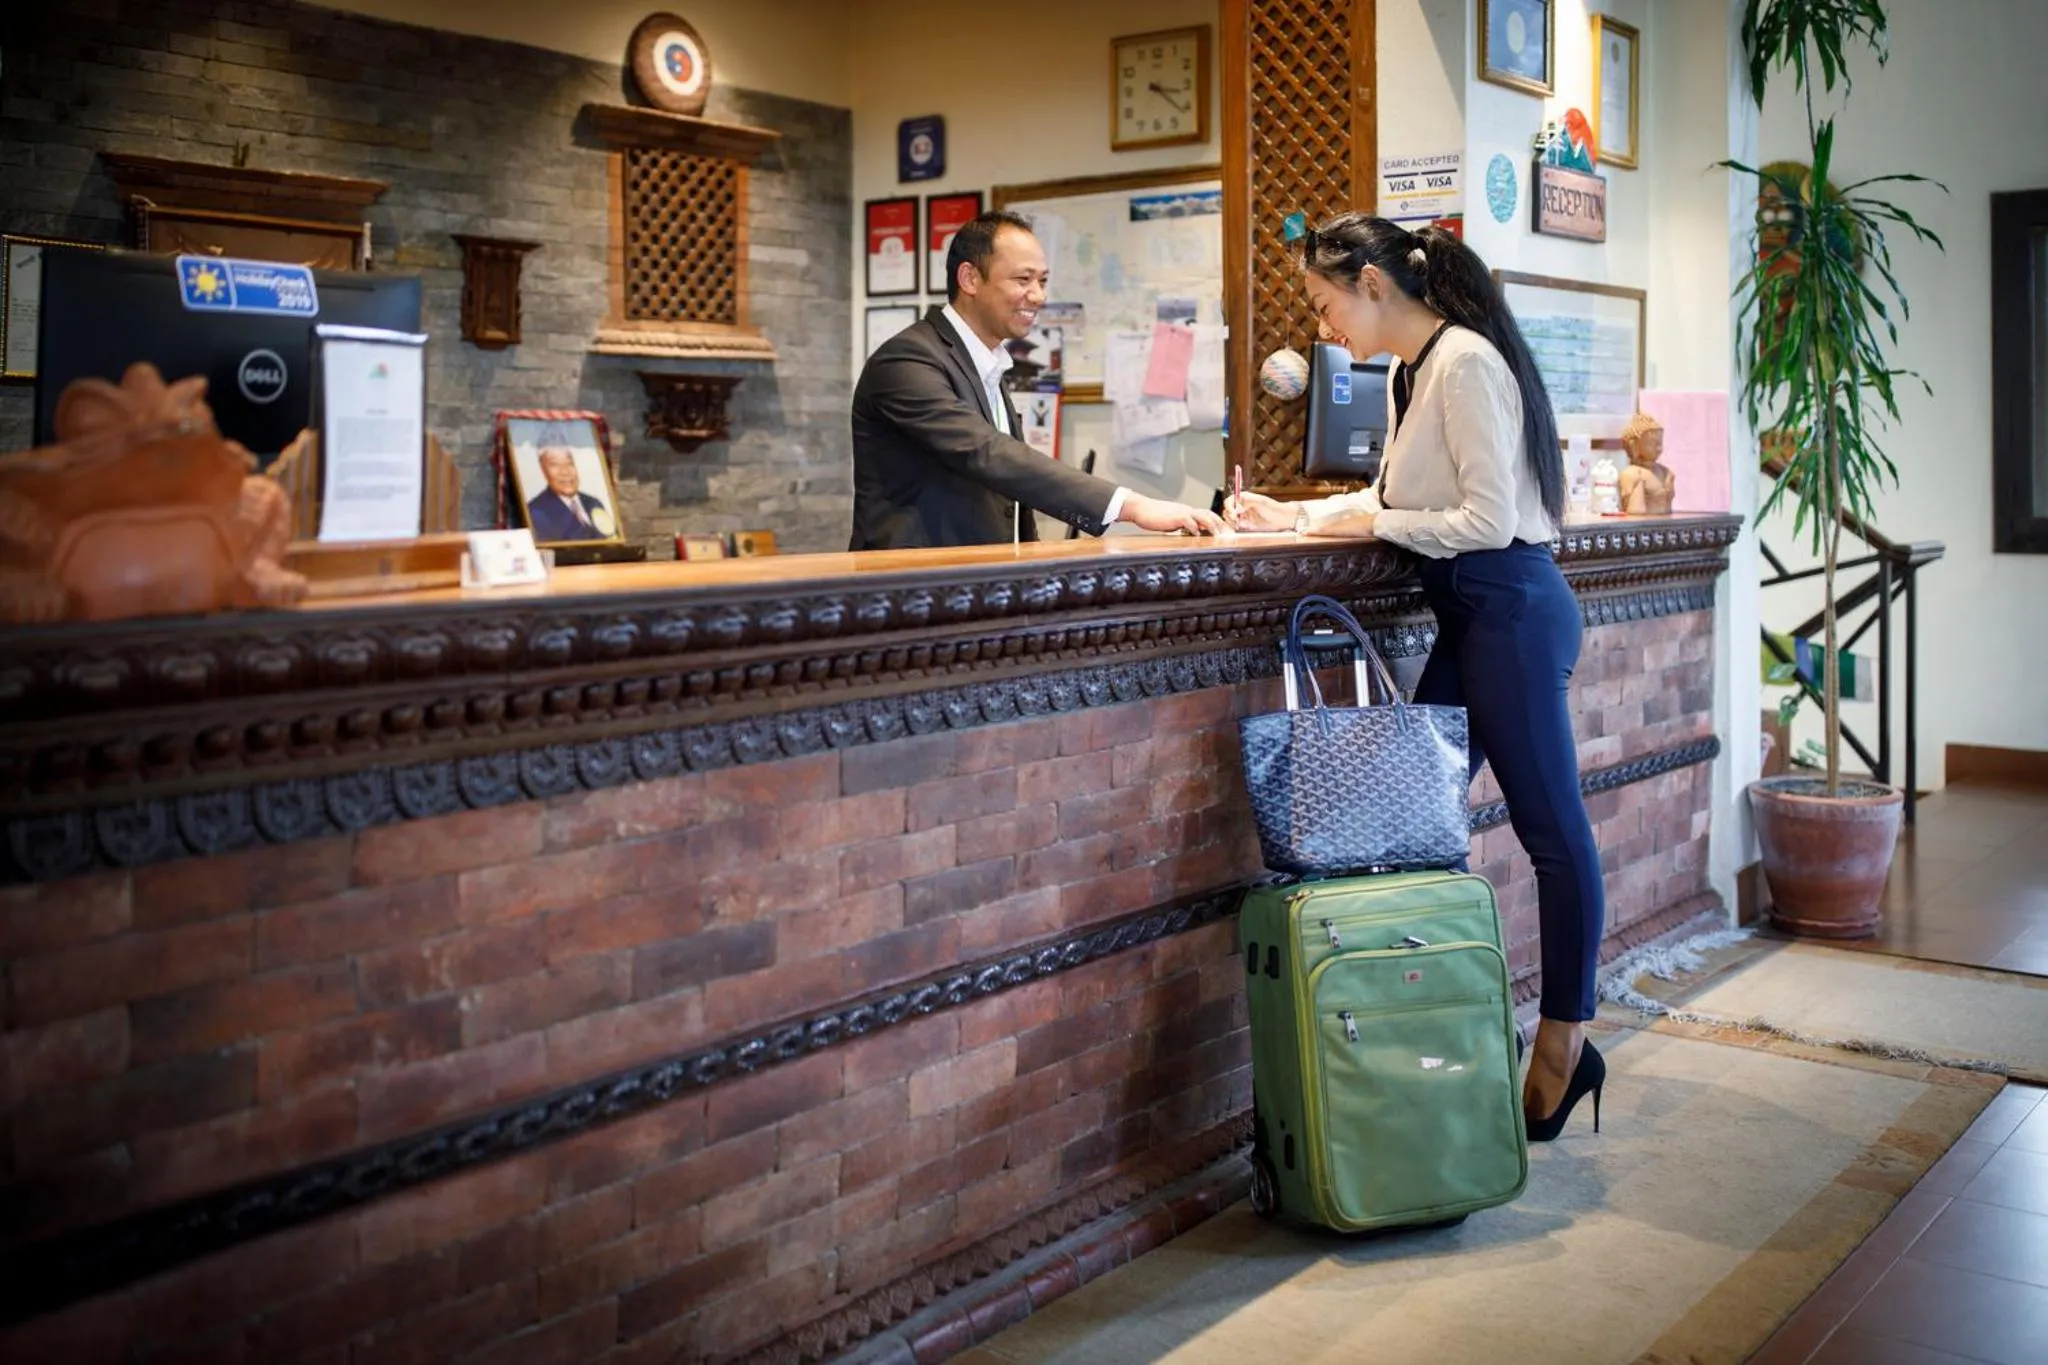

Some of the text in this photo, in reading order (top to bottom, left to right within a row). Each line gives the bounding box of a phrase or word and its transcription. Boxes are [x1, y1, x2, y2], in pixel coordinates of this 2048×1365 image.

[1384, 154, 1460, 170] CARD ACCEPTED
[1389, 176, 1453, 192] VISA VISA
[1542, 183, 1605, 222] RECEPTION
[245, 369, 280, 384] DELL
